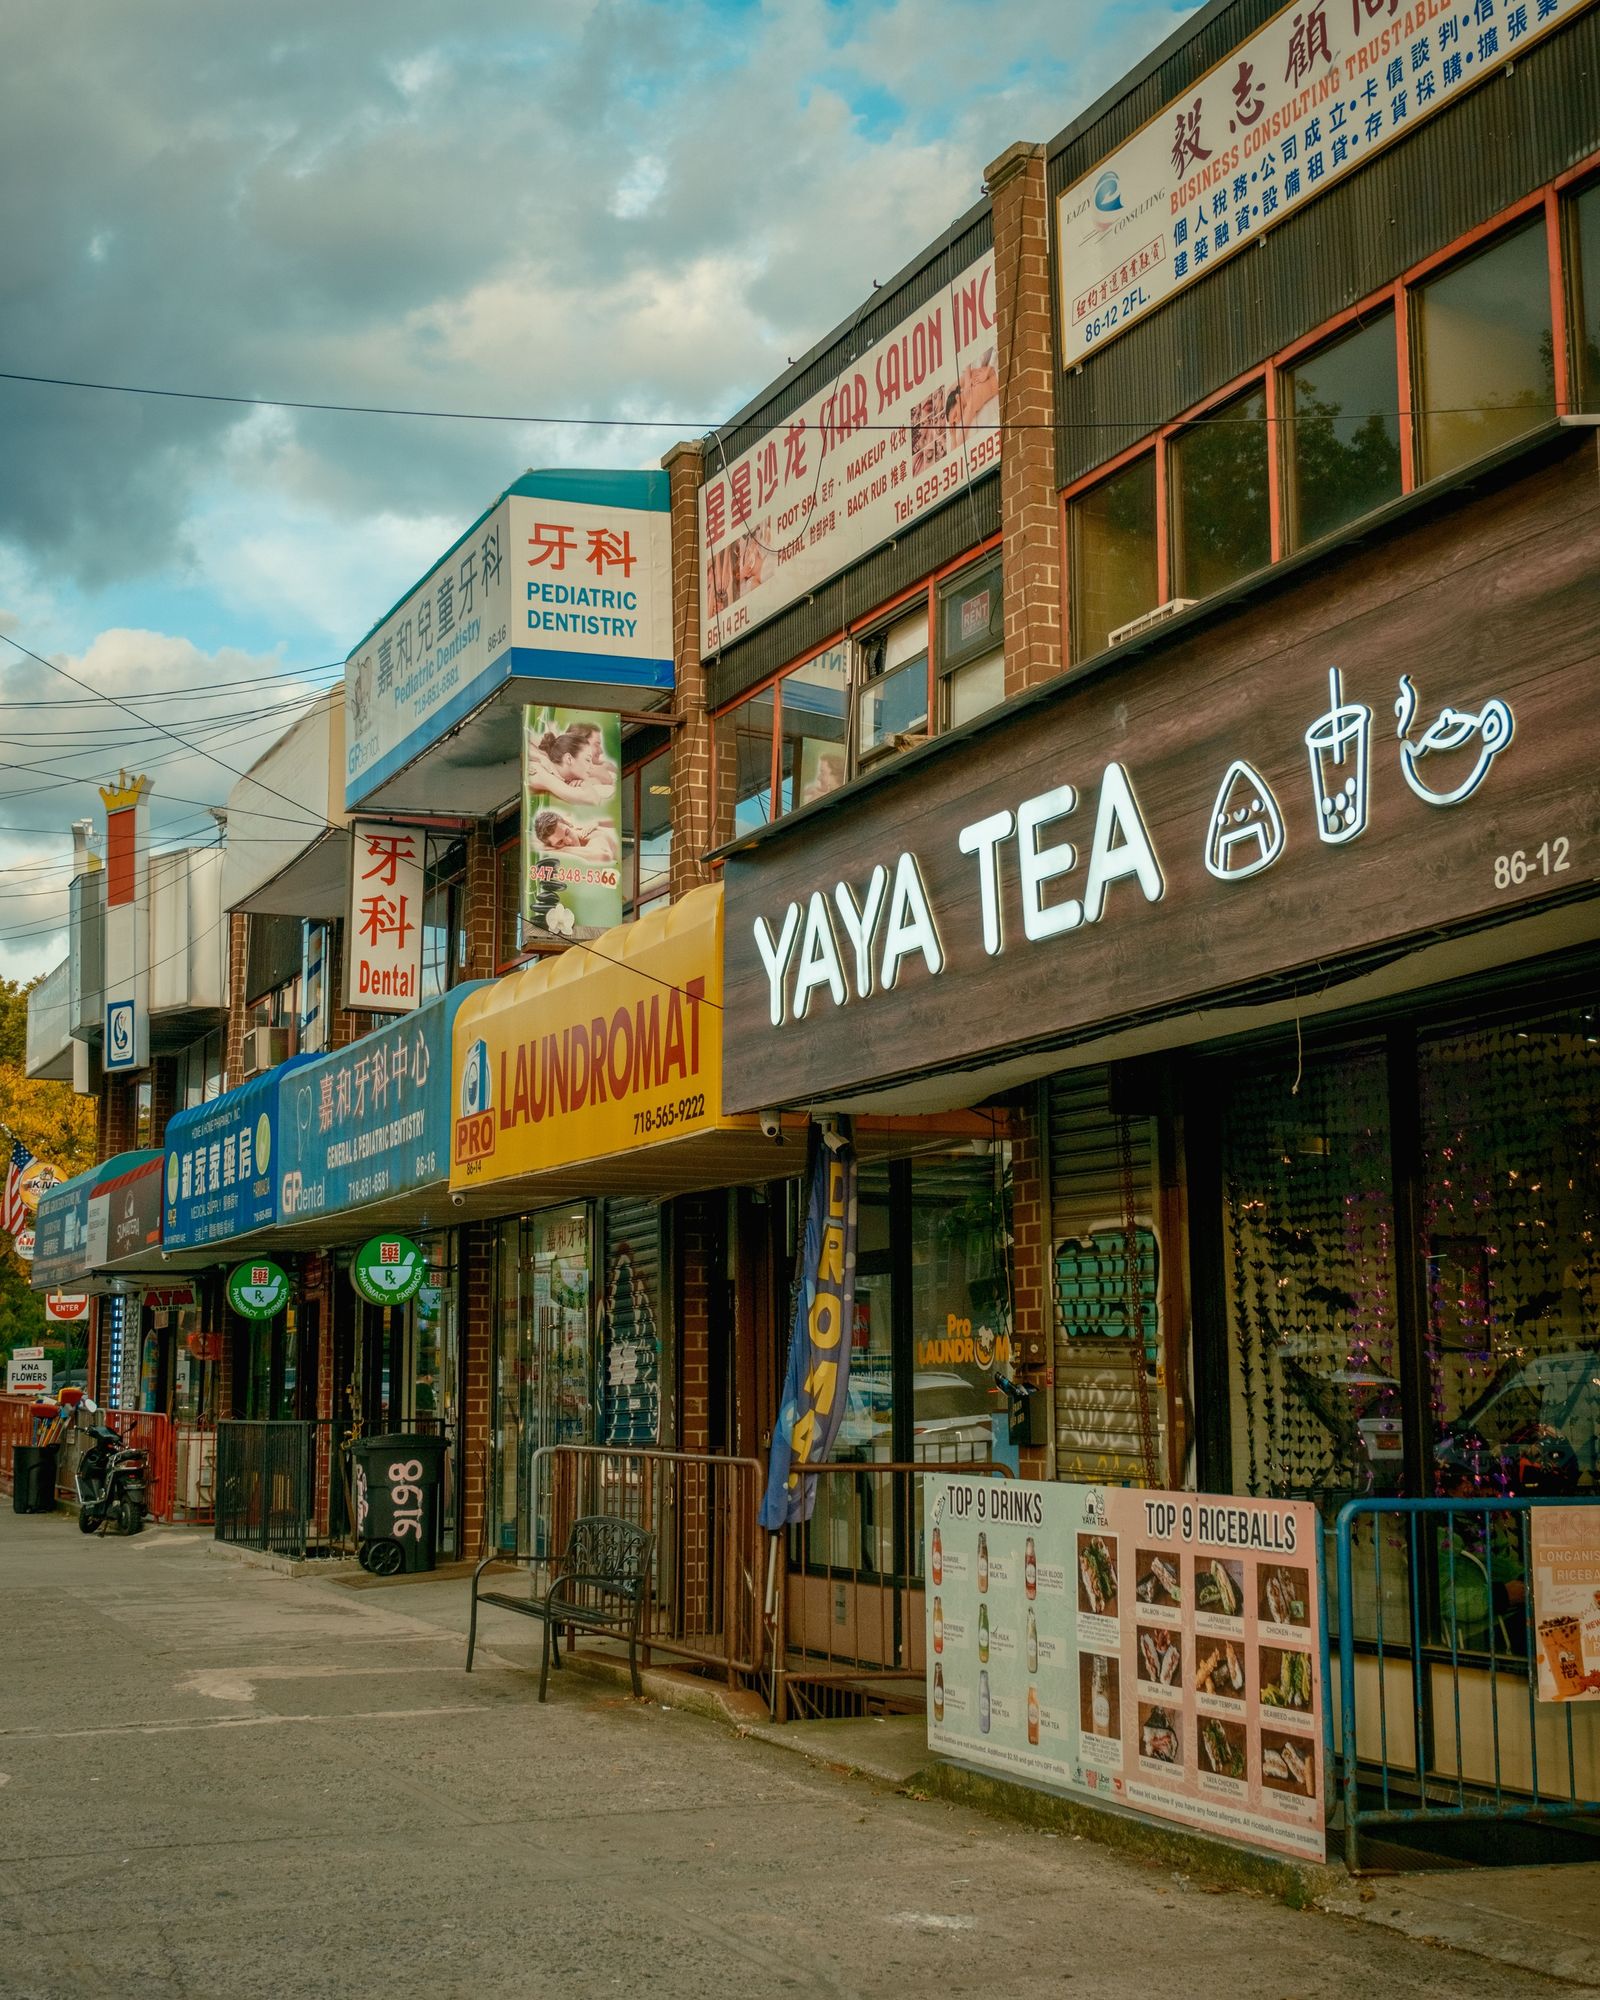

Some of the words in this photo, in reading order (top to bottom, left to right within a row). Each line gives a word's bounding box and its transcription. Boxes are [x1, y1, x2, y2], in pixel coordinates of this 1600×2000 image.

[1170, 145, 1239, 215] BUSINESS
[1243, 67, 1340, 160] CONSULTING
[1066, 196, 1092, 225] EAZZY
[1113, 187, 1166, 235] CONSULTING
[1085, 304, 1118, 343] 86-12
[1122, 286, 1151, 319] 2FL.
[819, 373, 868, 459] STAR
[876, 307, 943, 416] SALON
[846, 439, 886, 484] MAKEUP
[894, 494, 914, 524] Tel:
[916, 430, 1001, 510] 929-391-5993
[847, 487, 869, 518] BACK
[871, 474, 888, 503] RUB
[777, 503, 800, 535] FOOT
[802, 491, 818, 517] SPA
[527, 522, 638, 578] 牙科
[777, 534, 806, 567] FACIAL
[376, 523, 503, 699] 嘉和兒童牙科
[527, 581, 637, 611] PEDIATRIC
[527, 609, 638, 639] DENTISTRY
[707, 619, 731, 650] 86-14
[734, 604, 751, 634] 2FL
[963, 603, 988, 628] RENT
[487, 624, 507, 653] 86-16
[394, 658, 434, 710] Pediatric
[437, 616, 481, 672] Dentistry
[529, 864, 617, 887] 347-348-5366
[1493, 836, 1571, 891] 86-12
[358, 833, 416, 950] 牙科
[753, 851, 946, 1027] YAYA
[958, 761, 1166, 957] TEA
[359, 959, 415, 998] Dental
[500, 975, 705, 1131] LAUNDROMAT
[319, 1029, 430, 1134] 嘉和牙科中心
[633, 1093, 705, 1135] 718-565-9222
[327, 1139, 352, 1170] GENERAL
[353, 1137, 358, 1162] &
[358, 1123, 390, 1160] PEDIATRIC
[390, 1108, 425, 1149] DENTISTRY
[457, 1116, 493, 1158] PRO
[415, 1151, 435, 1177] 86-16
[466, 1158, 482, 1176] 86-14
[143, 1289, 194, 1307] ATM
[358, 1267, 390, 1301] PHARMACY
[396, 1266, 423, 1301] FARMACIA
[55, 1304, 80, 1312] ENTER
[232, 1287, 258, 1317] PHARMACY
[264, 1287, 288, 1316] FARMACIA
[947, 1313, 973, 1338] Pro
[11, 1372, 48, 1382] FLOWERS
[21, 1363, 39, 1371] KNA
[947, 1485, 973, 1516] TOP
[977, 1488, 986, 1518] 9
[991, 1489, 1042, 1524] DRINKS
[1082, 1516, 1096, 1525] YAYA
[1097, 1517, 1109, 1526] TEA
[1145, 1502, 1176, 1536] TOP
[1182, 1505, 1192, 1538] 9
[1199, 1507, 1295, 1550] RICEBALLS
[989, 1562, 1002, 1570] BLACK
[1049, 1571, 1063, 1579] BLOOD
[1039, 1641, 1056, 1650] MATCHA
[1266, 1626, 1288, 1636] CHICKEN
[1039, 1650, 1051, 1658] LATTE
[1560, 1662, 1577, 1672] YAYA
[1562, 1670, 1580, 1680] TEA
[1001, 1710, 1010, 1718] TEA
[1219, 1699, 1241, 1711] TEMPURA
[1263, 1709, 1287, 1720] SEAWEED
[1051, 1721, 1059, 1729] TEA
[1044, 1761, 1053, 1770] OFF
[1218, 1779, 1240, 1790] CHICKEN
[1129, 1786, 1143, 1797] Please
[1158, 1794, 1169, 1804] know
[1175, 1800, 1183, 1808] you
[1184, 1802, 1195, 1812] have
[1206, 1807, 1217, 1818] food
[1251, 1821, 1274, 1834] riceballs
[1274, 1828, 1295, 1839] contain
